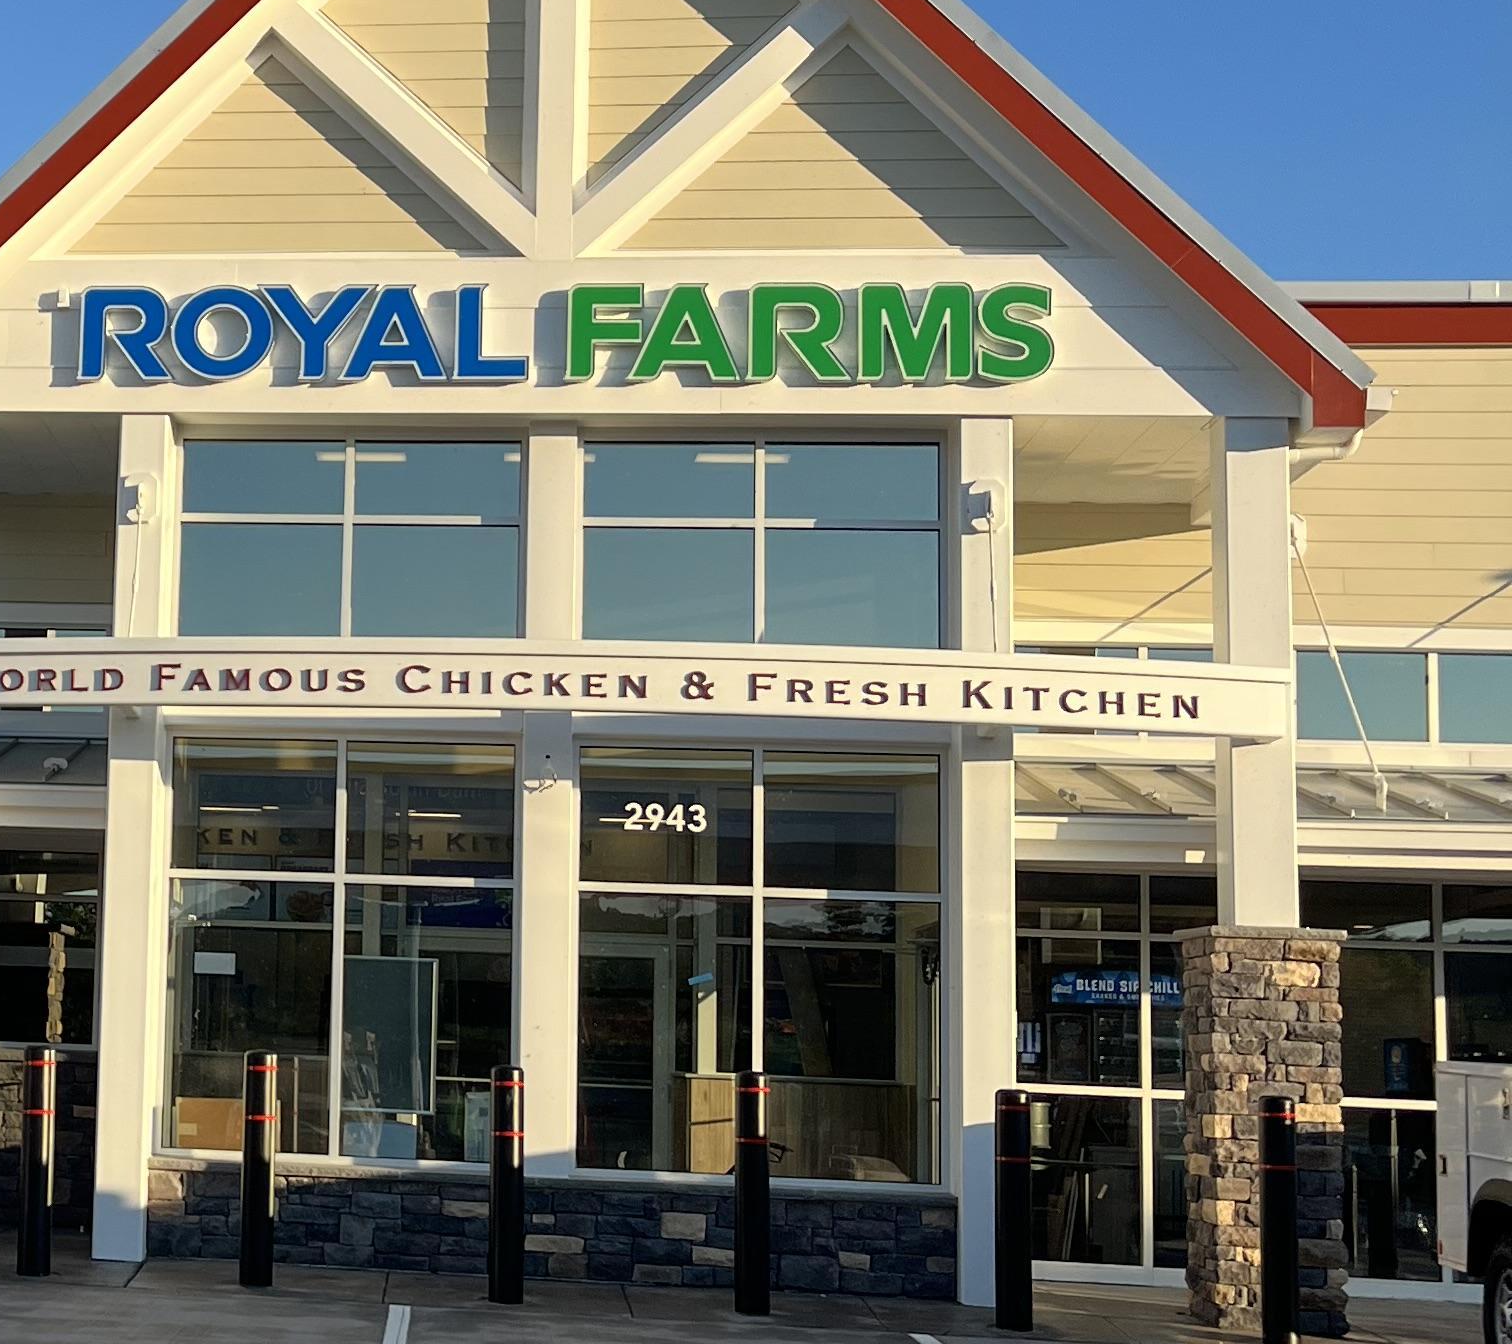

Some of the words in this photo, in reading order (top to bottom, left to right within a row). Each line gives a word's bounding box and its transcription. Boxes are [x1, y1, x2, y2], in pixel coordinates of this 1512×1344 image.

[77, 283, 529, 383] ROYAL
[563, 282, 1056, 384] FARMS
[680, 670, 716, 701] &
[624, 802, 707, 833] 2943
[1076, 979, 1114, 992] BLEND
